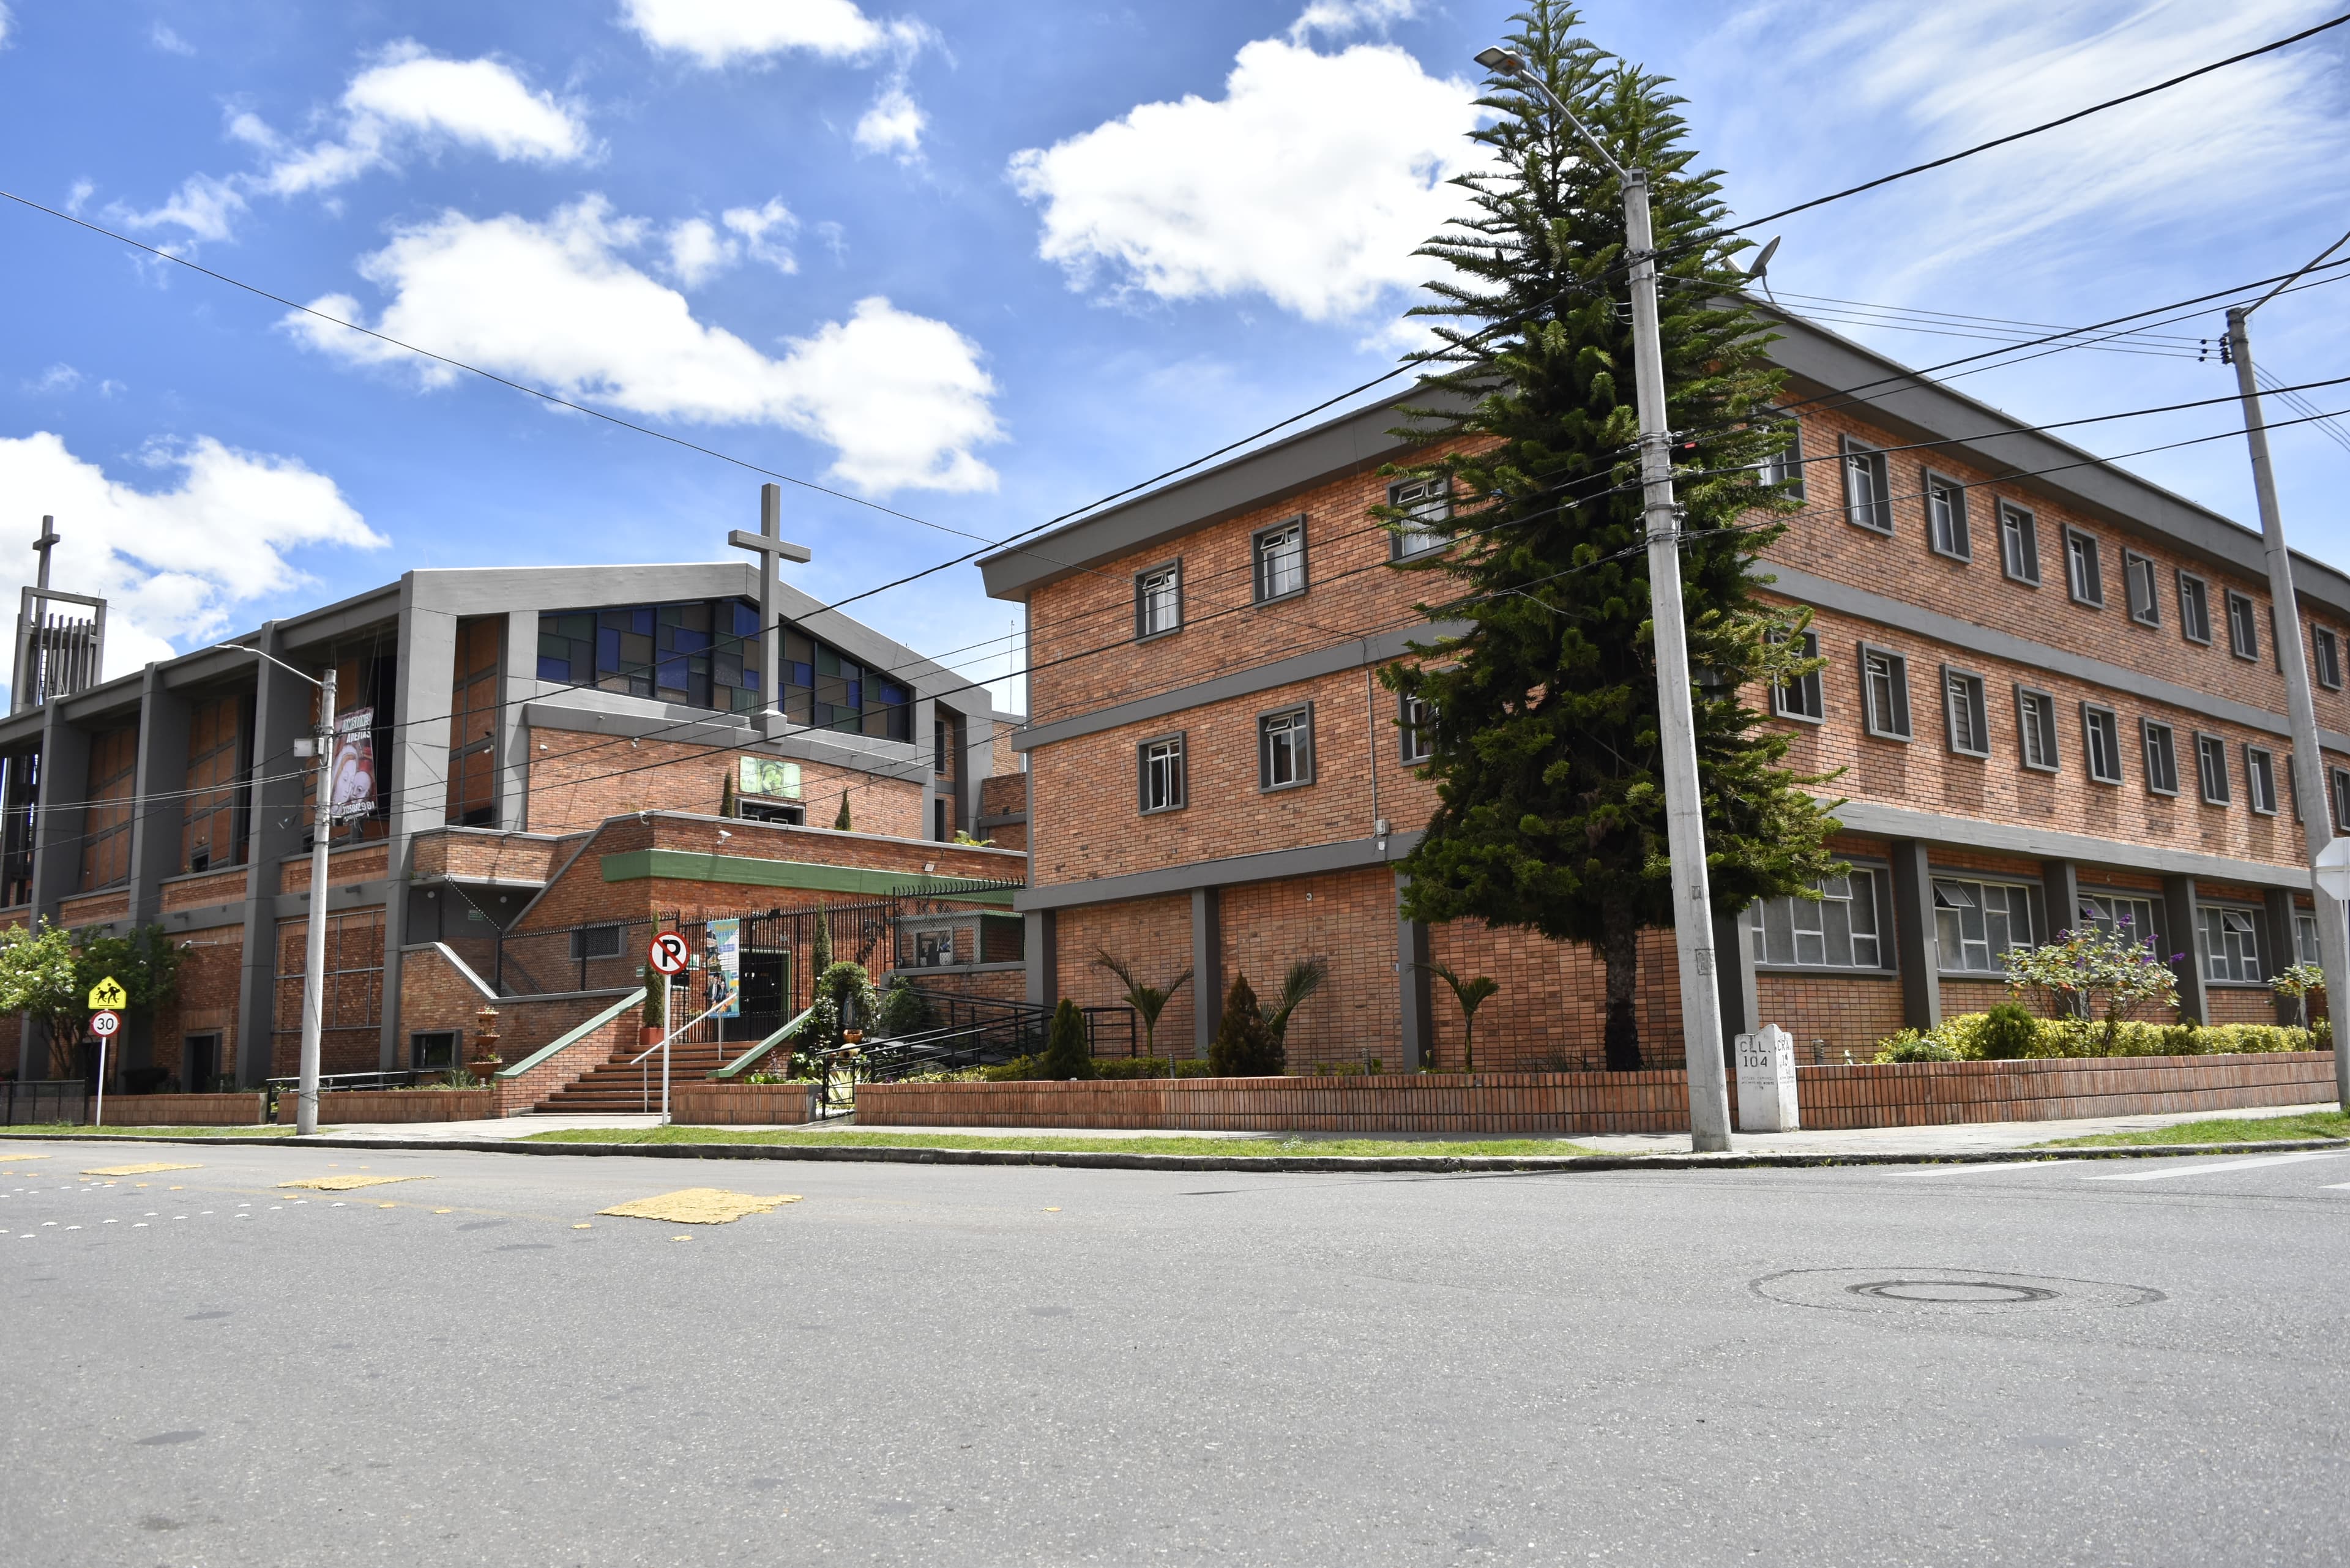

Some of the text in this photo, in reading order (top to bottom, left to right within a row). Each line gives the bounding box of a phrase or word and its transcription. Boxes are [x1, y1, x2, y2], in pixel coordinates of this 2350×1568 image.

[662, 939, 681, 967] P
[97, 1018, 114, 1030] 30
[1740, 1041, 1771, 1053] CLL.
[1777, 1040, 1791, 1051] CRA.
[1744, 1056, 1767, 1067] 104
